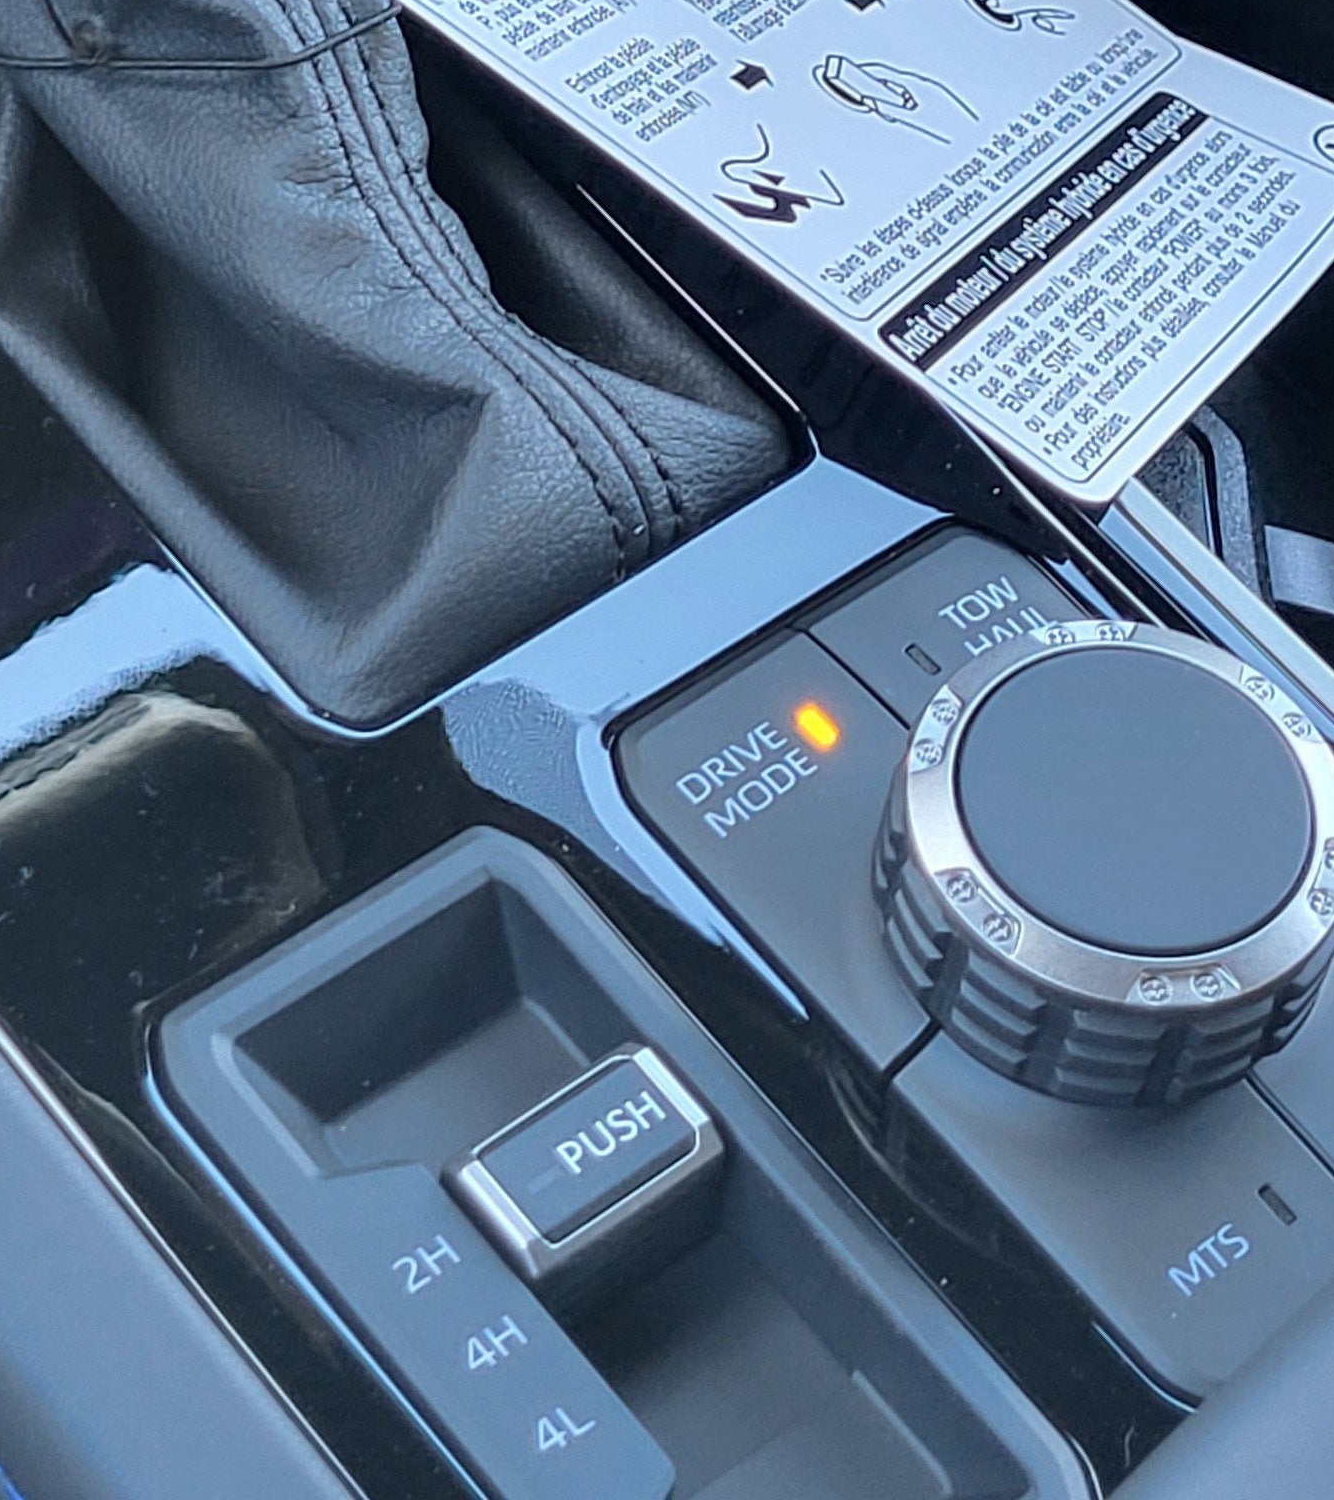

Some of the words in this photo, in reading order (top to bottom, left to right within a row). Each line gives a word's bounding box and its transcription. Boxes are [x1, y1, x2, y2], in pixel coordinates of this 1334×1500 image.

[1096, 160, 1128, 183] en
[1111, 142, 1147, 170] cas
[1048, 172, 1112, 220] hybride
[1010, 208, 1072, 260] système
[989, 247, 1026, 274] du
[944, 267, 1002, 316] moteur
[888, 315, 944, 362] Arrêt
[924, 303, 962, 332] du
[937, 576, 1019, 629] TOW
[676, 721, 789, 806] DRIVE
[703, 747, 819, 838] MODE
[557, 1090, 668, 1174] PUSH
[392, 1234, 461, 1295] 2H
[1167, 1223, 1250, 1298] MTS
[467, 1315, 529, 1372] 4H
[536, 1407, 596, 1453] 4L
